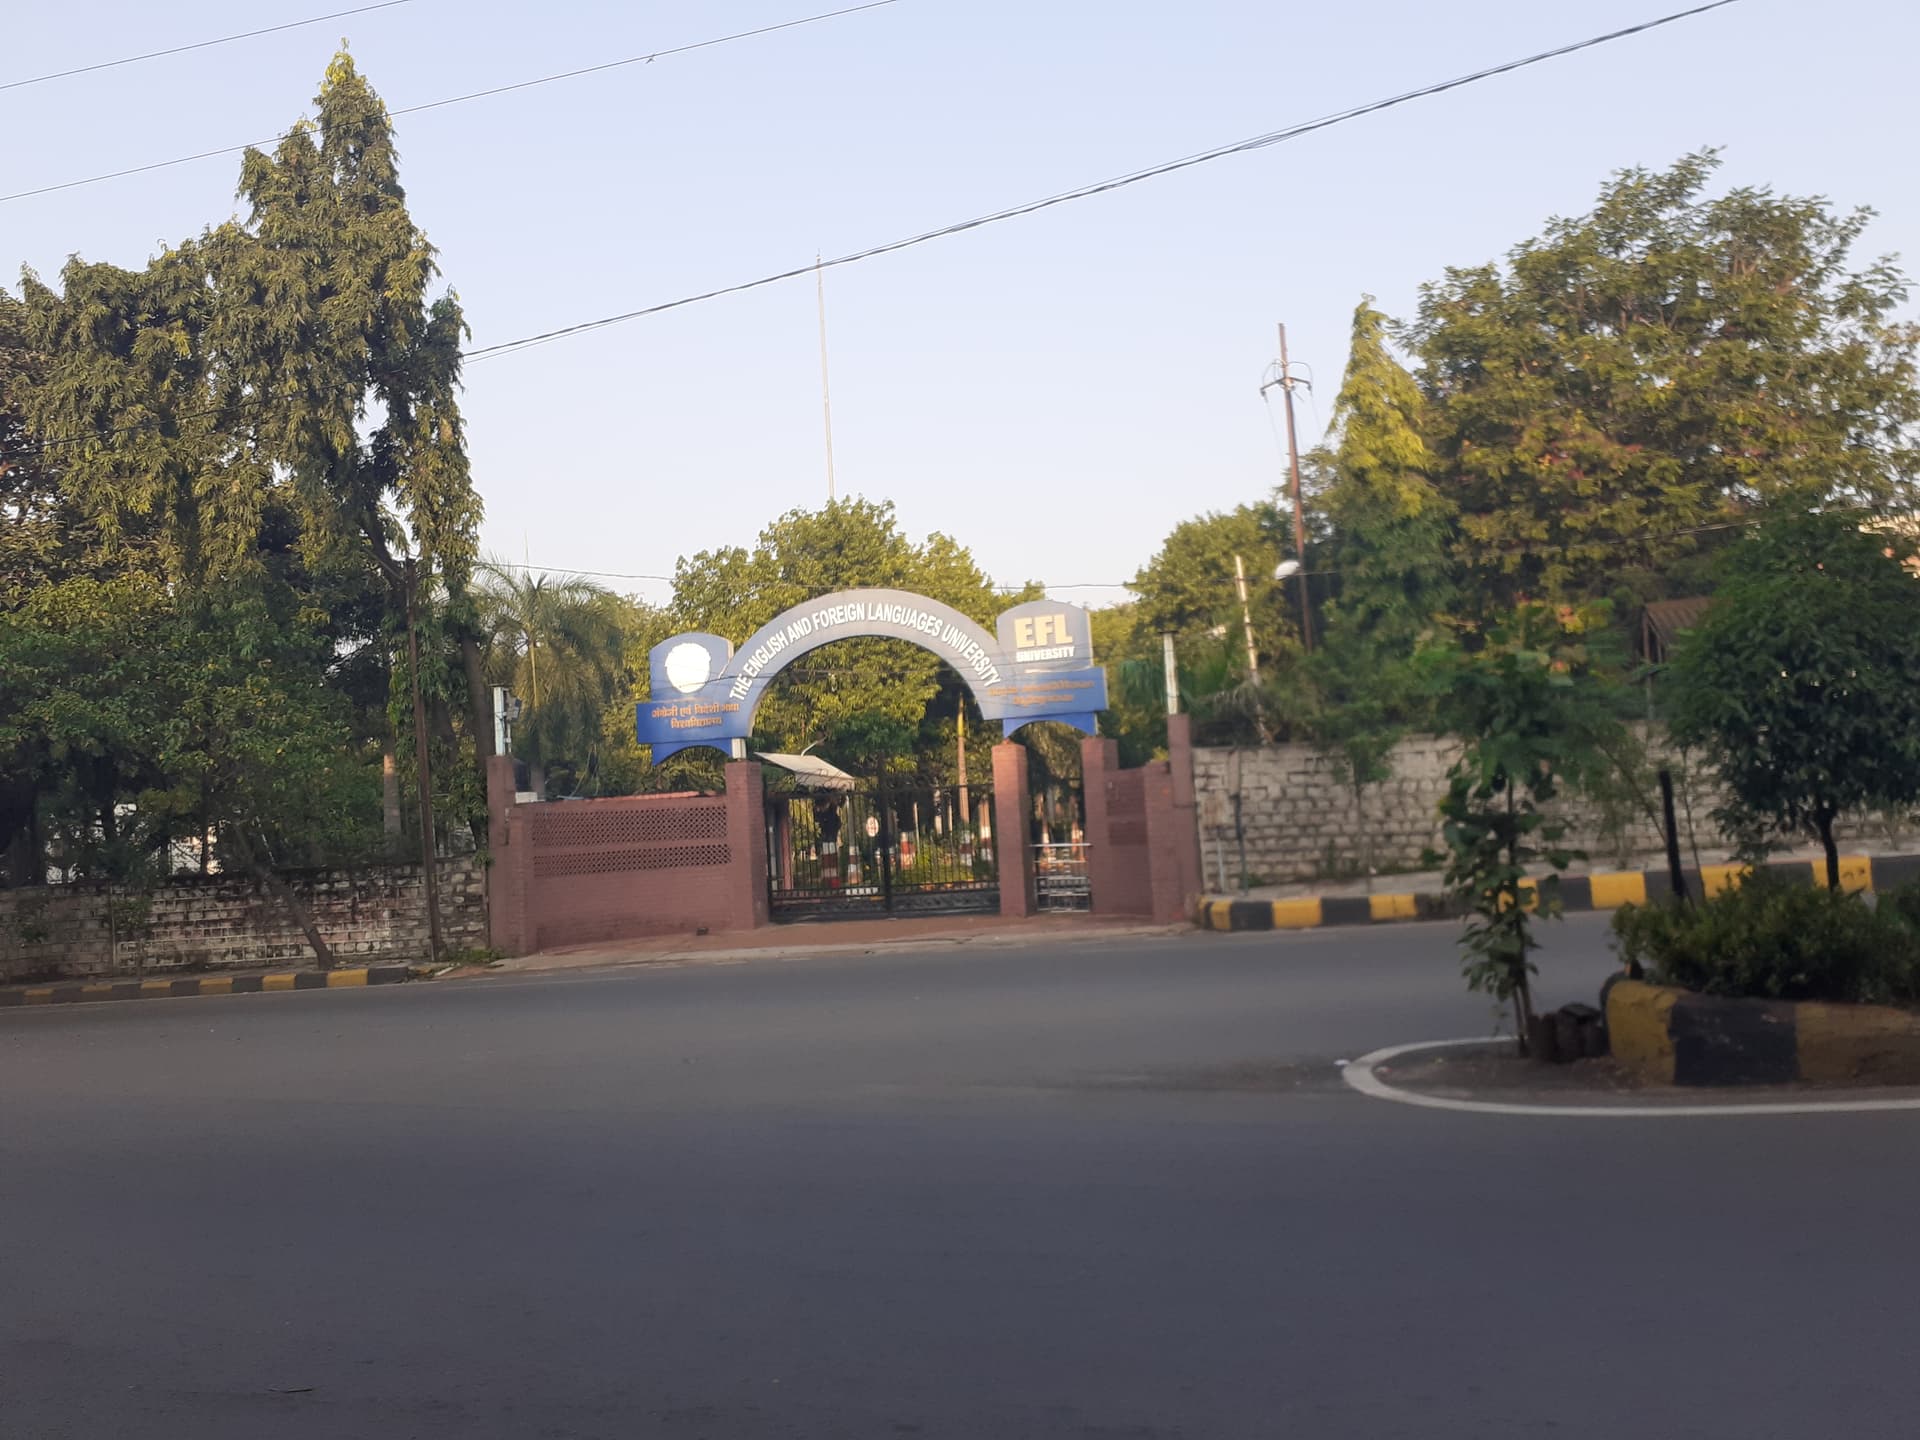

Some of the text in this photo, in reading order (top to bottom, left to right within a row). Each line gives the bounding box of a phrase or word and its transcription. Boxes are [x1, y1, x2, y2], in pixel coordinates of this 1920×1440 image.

[1014, 614, 1073, 648] EFL
[729, 673, 752, 701] THE
[748, 635, 788, 678] ENGLISH
[787, 618, 812, 641] AND
[813, 603, 866, 630] FOREIGN
[868, 603, 943, 636] LANGUAGES
[940, 625, 1001, 688] UNIVERSITY
[1016, 646, 1075, 662] UNIVERSITY
